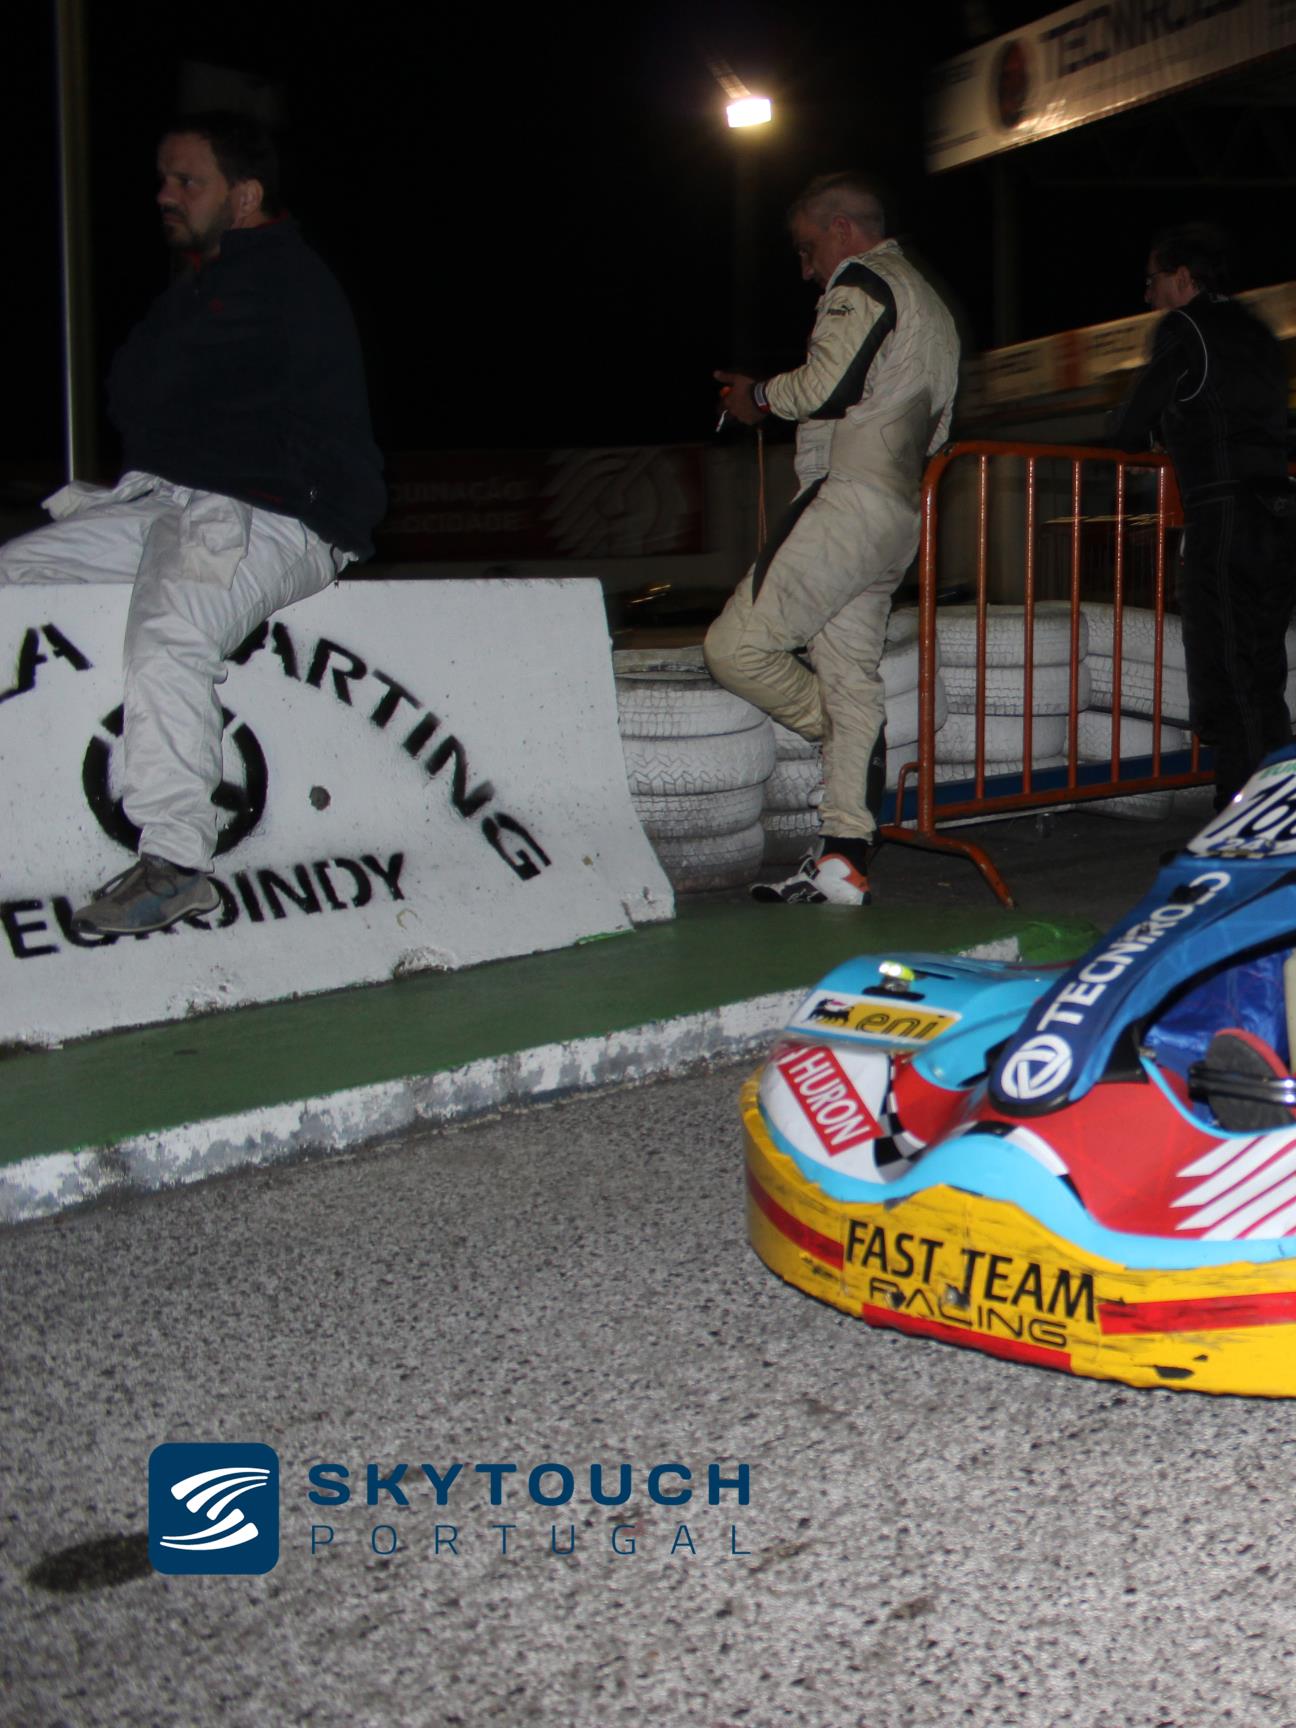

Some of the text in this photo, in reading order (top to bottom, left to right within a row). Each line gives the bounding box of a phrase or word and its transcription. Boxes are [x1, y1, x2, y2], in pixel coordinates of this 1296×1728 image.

[222, 619, 552, 882] ARTING
[0, 851, 405, 960] EUOINDY
[855, 1013, 946, 1041] eni
[788, 1048, 872, 1147] HURON
[846, 1218, 1097, 1324] FAST TEAM
